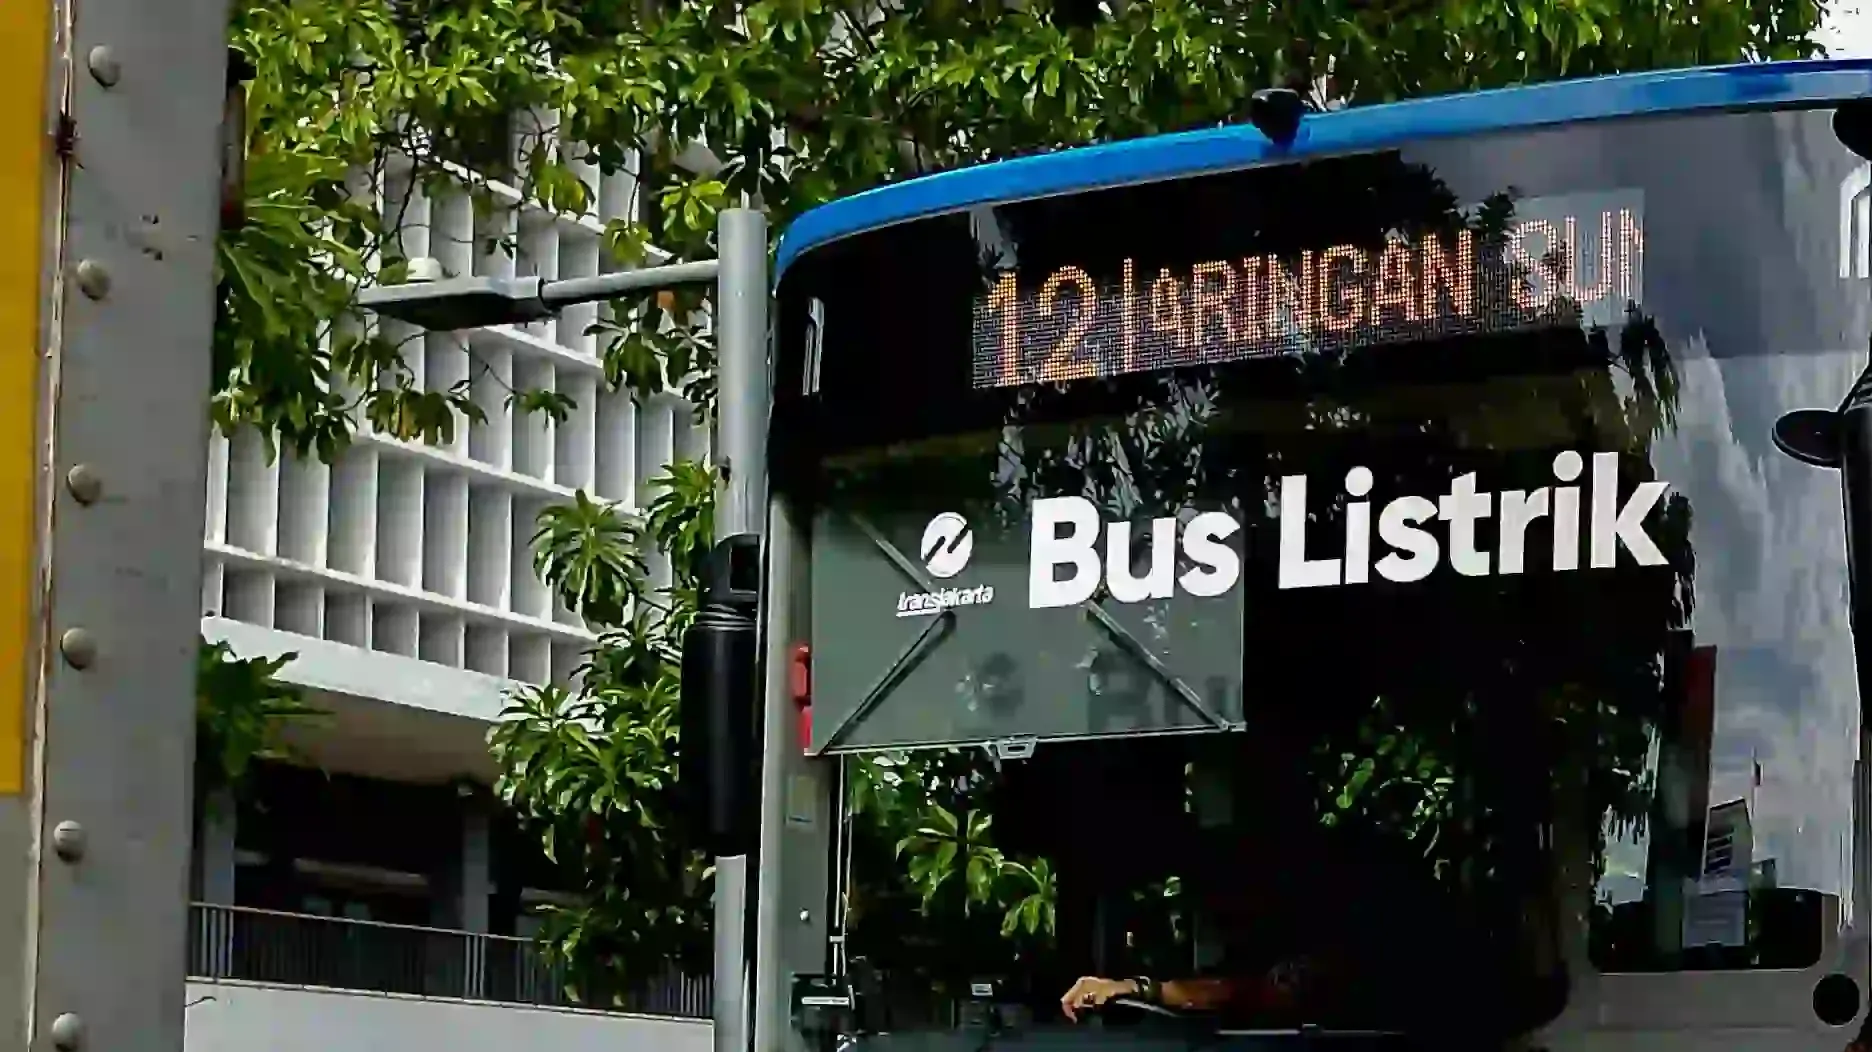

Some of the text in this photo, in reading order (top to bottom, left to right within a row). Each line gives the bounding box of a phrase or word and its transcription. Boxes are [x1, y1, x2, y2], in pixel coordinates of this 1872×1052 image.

[987, 265, 1098, 386] 12
[1029, 449, 1672, 609] Bus Listrik
